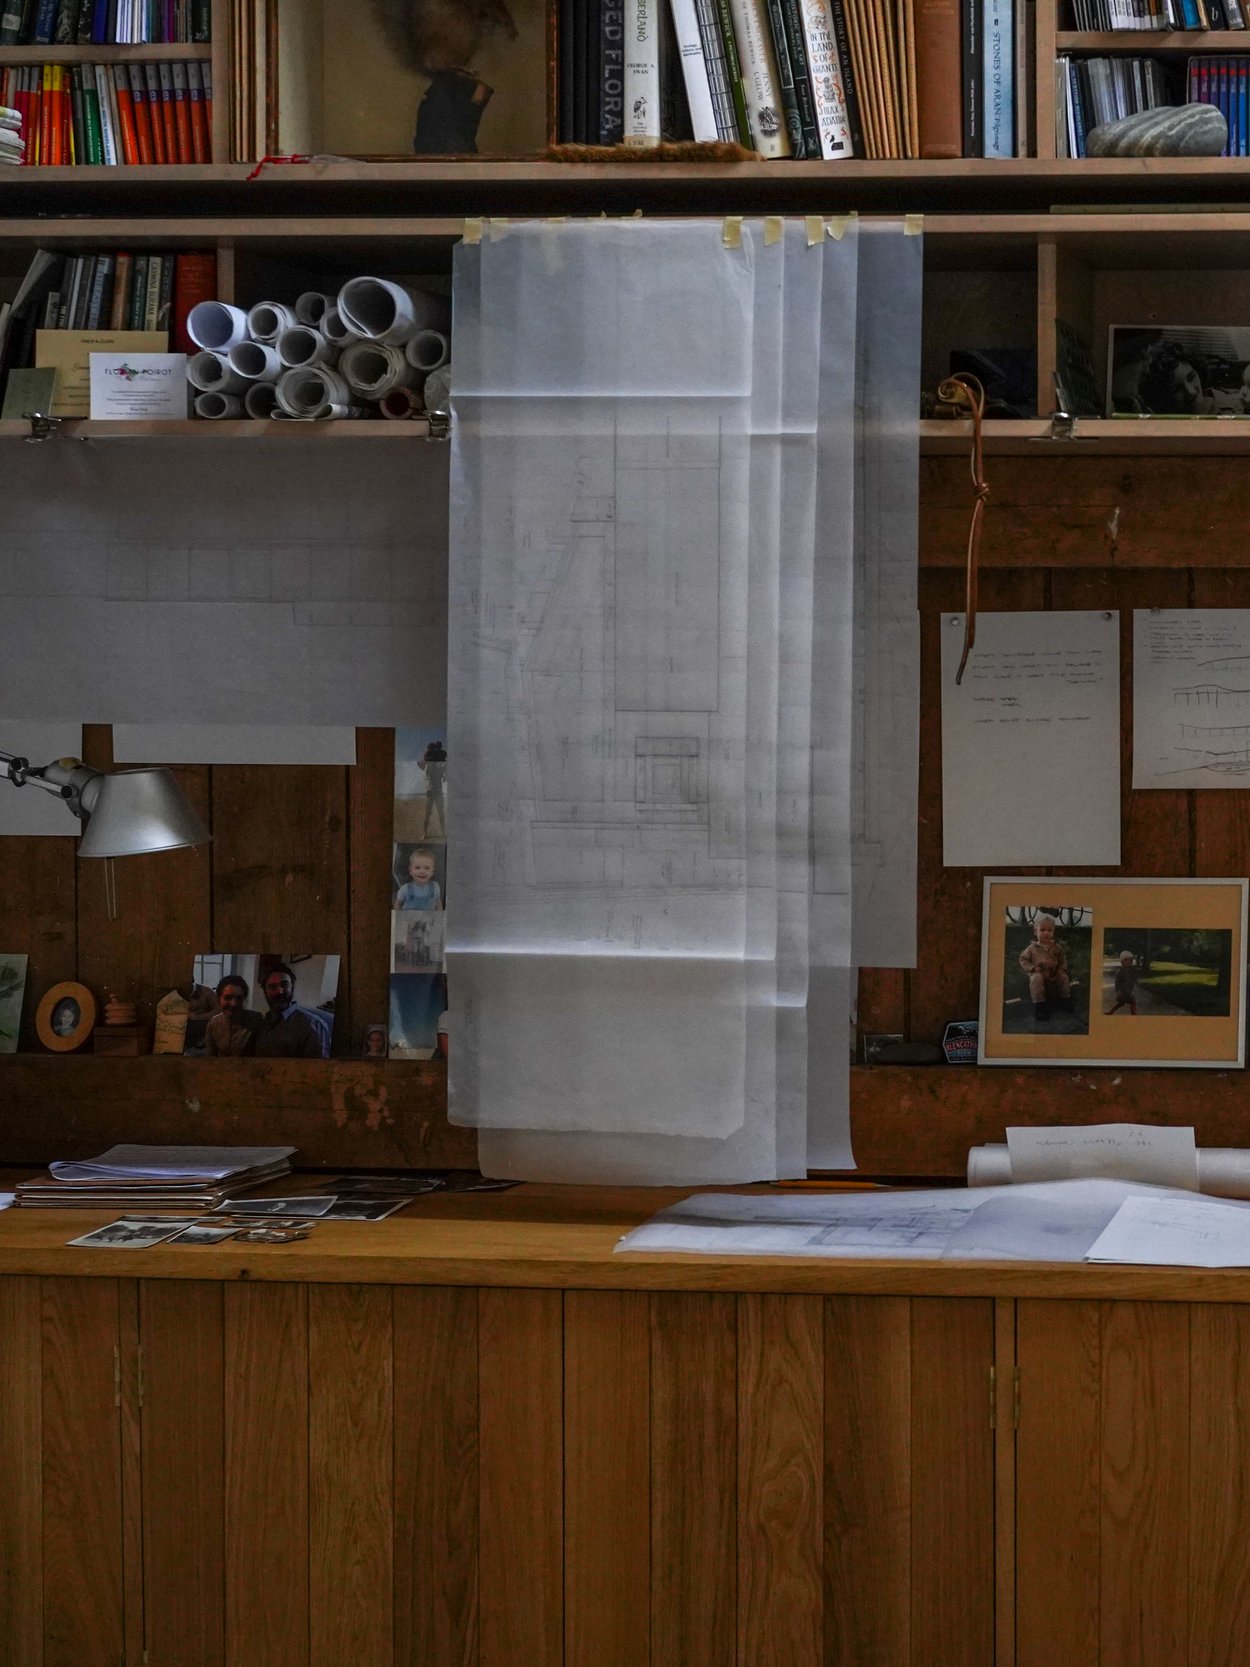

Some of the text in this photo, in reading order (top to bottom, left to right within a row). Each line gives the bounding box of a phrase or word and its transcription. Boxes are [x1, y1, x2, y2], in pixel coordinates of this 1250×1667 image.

[836, 16, 846, 42] STORY
[812, 42, 834, 53] LAND
[840, 42, 847, 54] OF
[993, 32, 1001, 70] STONES
[819, 53, 827, 63] OF
[842, 54, 849, 67] AN
[812, 64, 838, 74] GIANTS
[754, 71, 765, 101] UGLOW
[762, 72, 772, 97] JENNY
[844, 67, 854, 95] ISLAND
[993, 73, 1001, 86] OF
